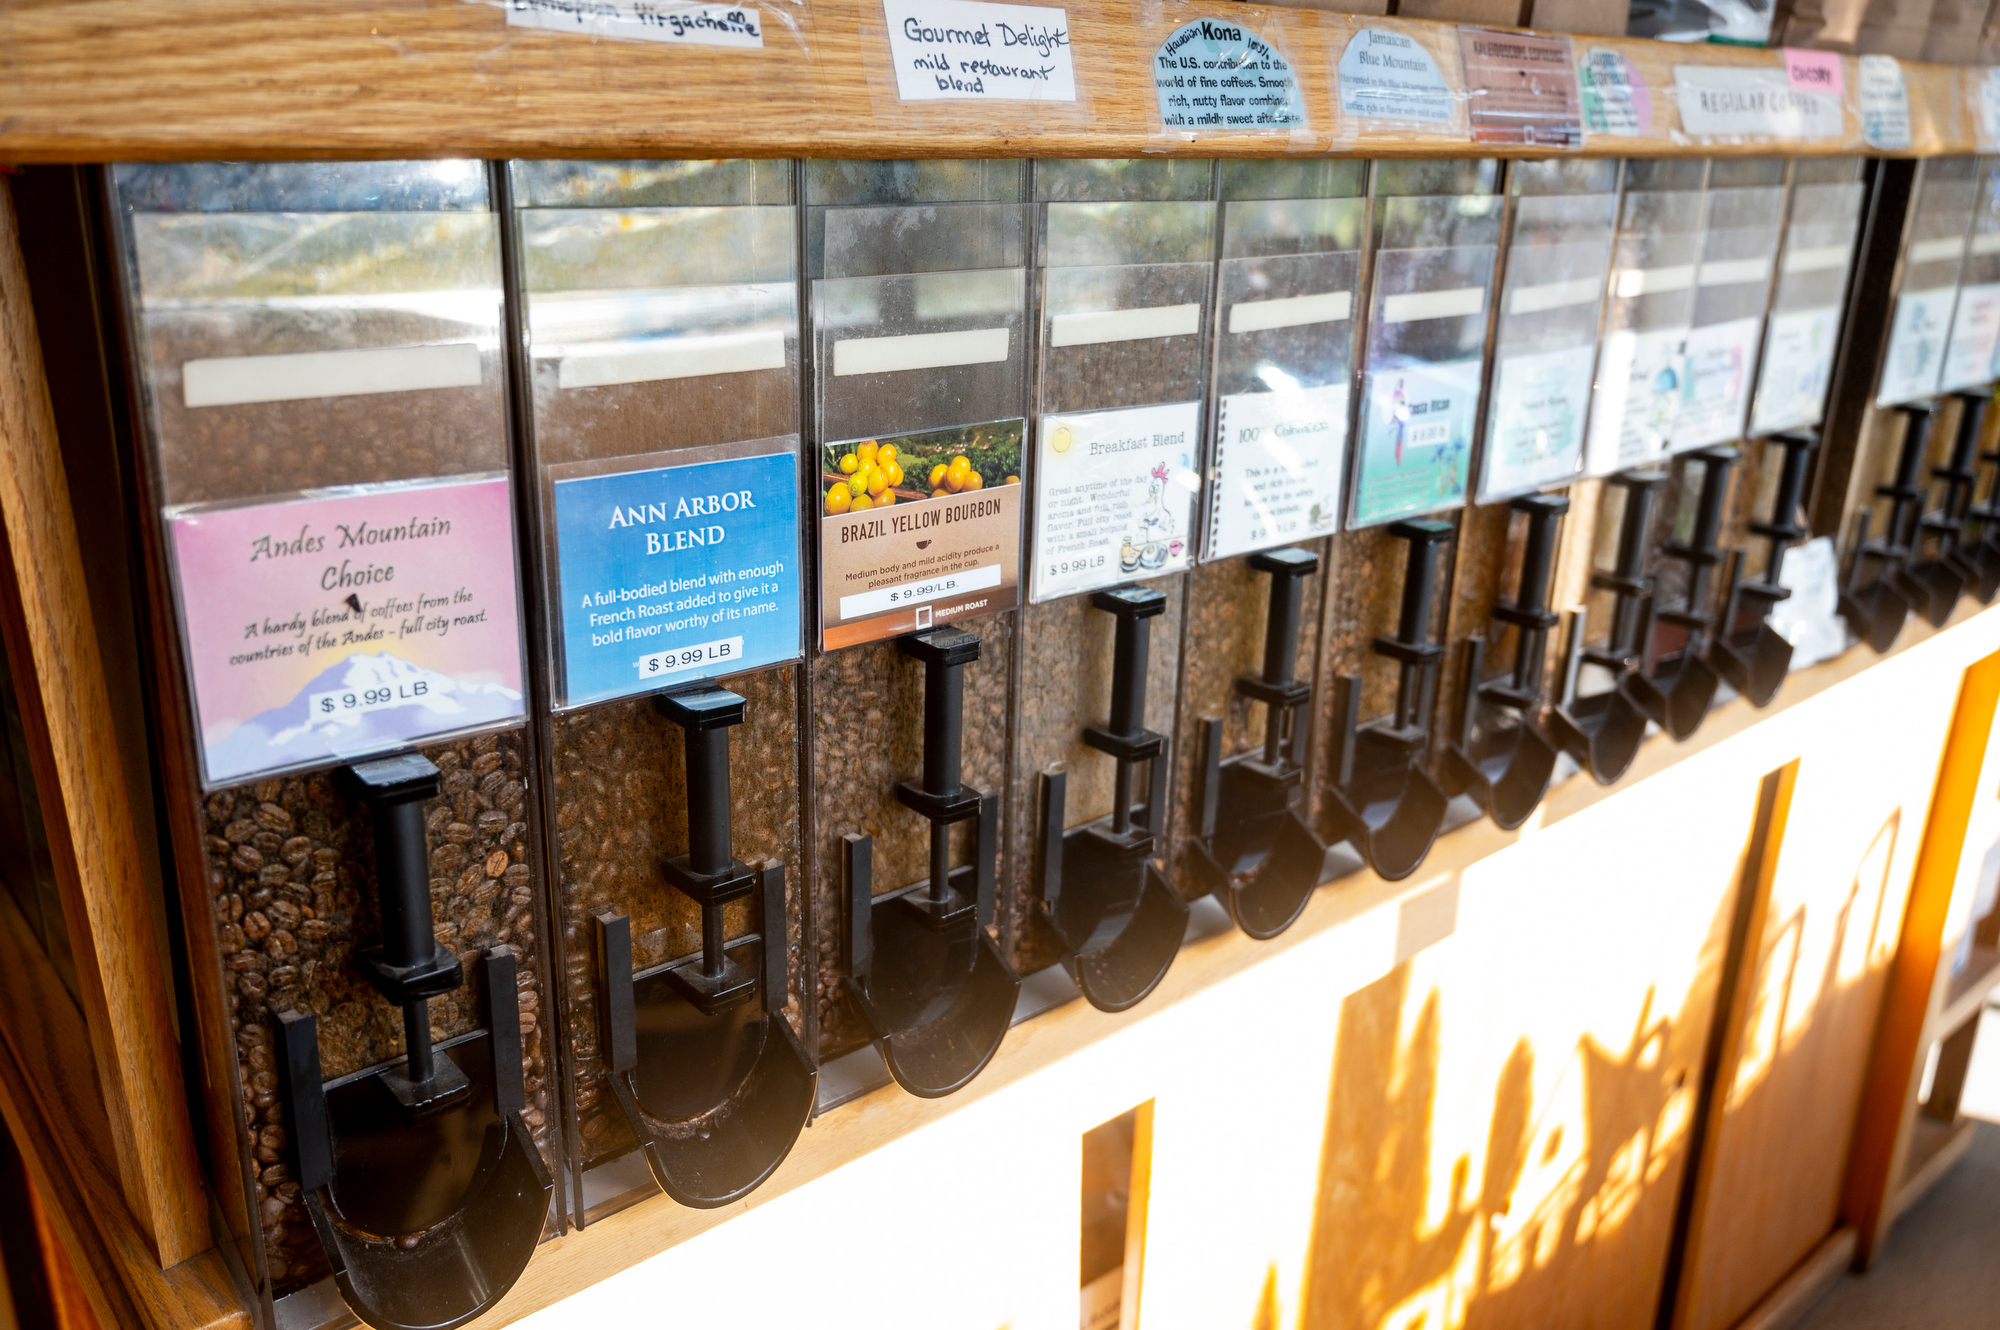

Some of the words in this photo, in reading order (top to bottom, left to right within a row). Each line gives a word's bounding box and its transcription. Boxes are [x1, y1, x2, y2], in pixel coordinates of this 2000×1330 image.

[904, 17, 991, 47] Gourmet
[996, 23, 1069, 58] Delight
[1202, 22, 1241, 41] Kona
[1368, 30, 1411, 48] Jamaican
[914, 53, 950, 70] mild
[960, 59, 1055, 80] restaurant
[1159, 57, 1177, 68] The
[1180, 58, 1200, 68] U.S.
[1204, 59, 1258, 69] contribution
[1261, 60, 1270, 69] to
[1274, 59, 1287, 70] the
[1359, 51, 1380, 66] Blue
[1383, 54, 1427, 72] Mountain
[935, 75, 984, 93] blend
[1157, 76, 1183, 87] world
[1188, 76, 1197, 87] of
[1200, 76, 1217, 87] fine
[1221, 77, 1256, 87] coffees.
[1169, 94, 1190, 108] rich,
[1193, 96, 1217, 108] nutty
[1221, 95, 1245, 106] flavor
[1701, 92, 1766, 114] REGULAR
[1165, 114, 1184, 125] with
[1198, 113, 1223, 125] mildly
[1227, 114, 1253, 124] sweet
[1090, 437, 1147, 455] Breakfast
[1152, 432, 1184, 447] Blend
[1049, 486, 1072, 497] Great
[1075, 481, 1107, 493] anytime
[1120, 478, 1132, 486] the
[1135, 475, 1148, 486] day
[1090, 490, 1130, 501] Wonderful
[841, 520, 886, 543] BRAZIL
[892, 509, 941, 534] YELLOW
[946, 499, 1000, 523] BOURBON
[1048, 509, 1074, 520] aroma
[1077, 506, 1091, 515] and
[1112, 501, 1128, 510] rich
[1078, 518, 1093, 528] Full
[1096, 516, 1111, 525] city
[1113, 511, 1132, 521] roast
[251, 523, 325, 561] Andes
[335, 516, 452, 549] Mountain
[1048, 534, 1065, 543] with
[1076, 529, 1097, 538] small
[1046, 546, 1055, 555] of
[1057, 542, 1085, 553] French
[846, 569, 877, 581] Medium
[880, 564, 900, 577] body
[902, 560, 916, 570] and
[919, 556, 935, 566] mild
[937, 551, 961, 564] acidity
[964, 545, 993, 559] produce
[868, 575, 901, 589] pleasant
[904, 568, 939, 582] fragrance
[942, 564, 948, 572] in
[950, 562, 962, 570] the
[964, 558, 979, 569] cup.
[1050, 565, 1057, 576] $
[1061, 560, 1086, 573] 9.99
[1090, 555, 1104, 568] LB
[320, 559, 395, 591] Choice
[582, 594, 592, 608] A
[595, 581, 667, 605] full-bodied
[671, 575, 706, 592] blend
[709, 567, 735, 585] with
[739, 561, 784, 581] enough
[891, 592, 899, 601] $
[904, 580, 958, 599] 9.99/LB.
[245, 622, 258, 639] A
[262, 615, 306, 639] hardy
[312, 607, 349, 627] blend
[354, 601, 367, 621] of
[371, 597, 413, 619] coffees
[417, 593, 449, 614] from
[454, 586, 473, 604] the
[590, 606, 636, 626] French
[638, 601, 673, 617] Roast
[676, 591, 716, 610] added
[719, 591, 731, 603] to
[734, 584, 759, 603] give
[762, 582, 769, 594] it
[772, 582, 778, 592] a
[935, 605, 963, 618] MEDIUM
[965, 599, 988, 610] ROAST
[592, 628, 623, 647] bold
[626, 622, 662, 640] flavor
[665, 612, 709, 633] worthy
[712, 610, 724, 623] of
[727, 606, 740, 619] its
[743, 601, 778, 617] name.
[229, 639, 293, 666] countries
[298, 634, 311, 656] of
[316, 630, 338, 651] the
[342, 627, 383, 646] Andes
[400, 616, 423, 639] full
[426, 615, 449, 638] city
[454, 609, 487, 627] roast.
[649, 658, 659, 672] $
[665, 650, 702, 668] 9.99
[708, 643, 731, 659] LB
[320, 697, 335, 713] $
[343, 687, 391, 709] 9.99
[400, 681, 429, 698] LB
